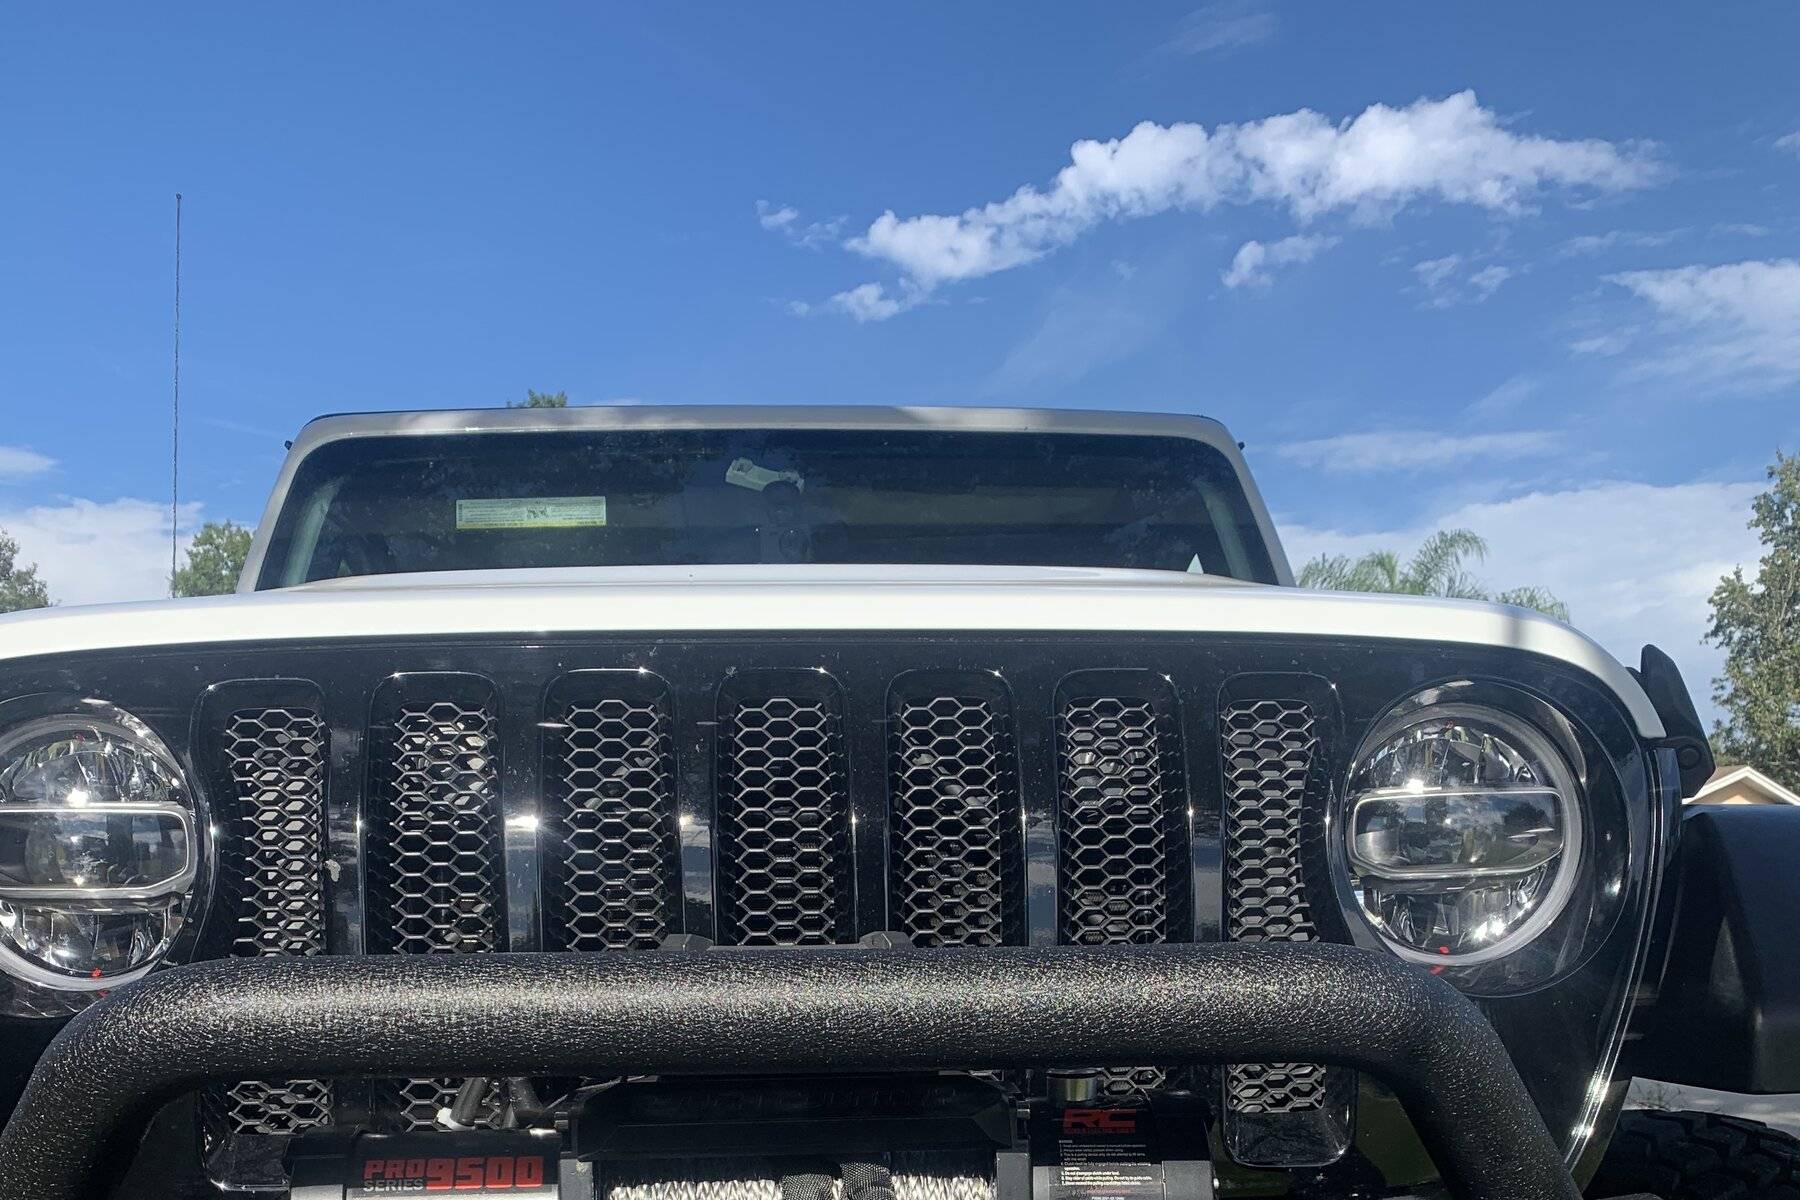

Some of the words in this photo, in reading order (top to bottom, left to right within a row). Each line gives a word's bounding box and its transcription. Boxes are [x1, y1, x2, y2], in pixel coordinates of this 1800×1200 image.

[1063, 1108, 1137, 1128] RC
[364, 1159, 426, 1179] PRO
[425, 1156, 545, 1190] 9500
[363, 1178, 424, 1192] SERIES
